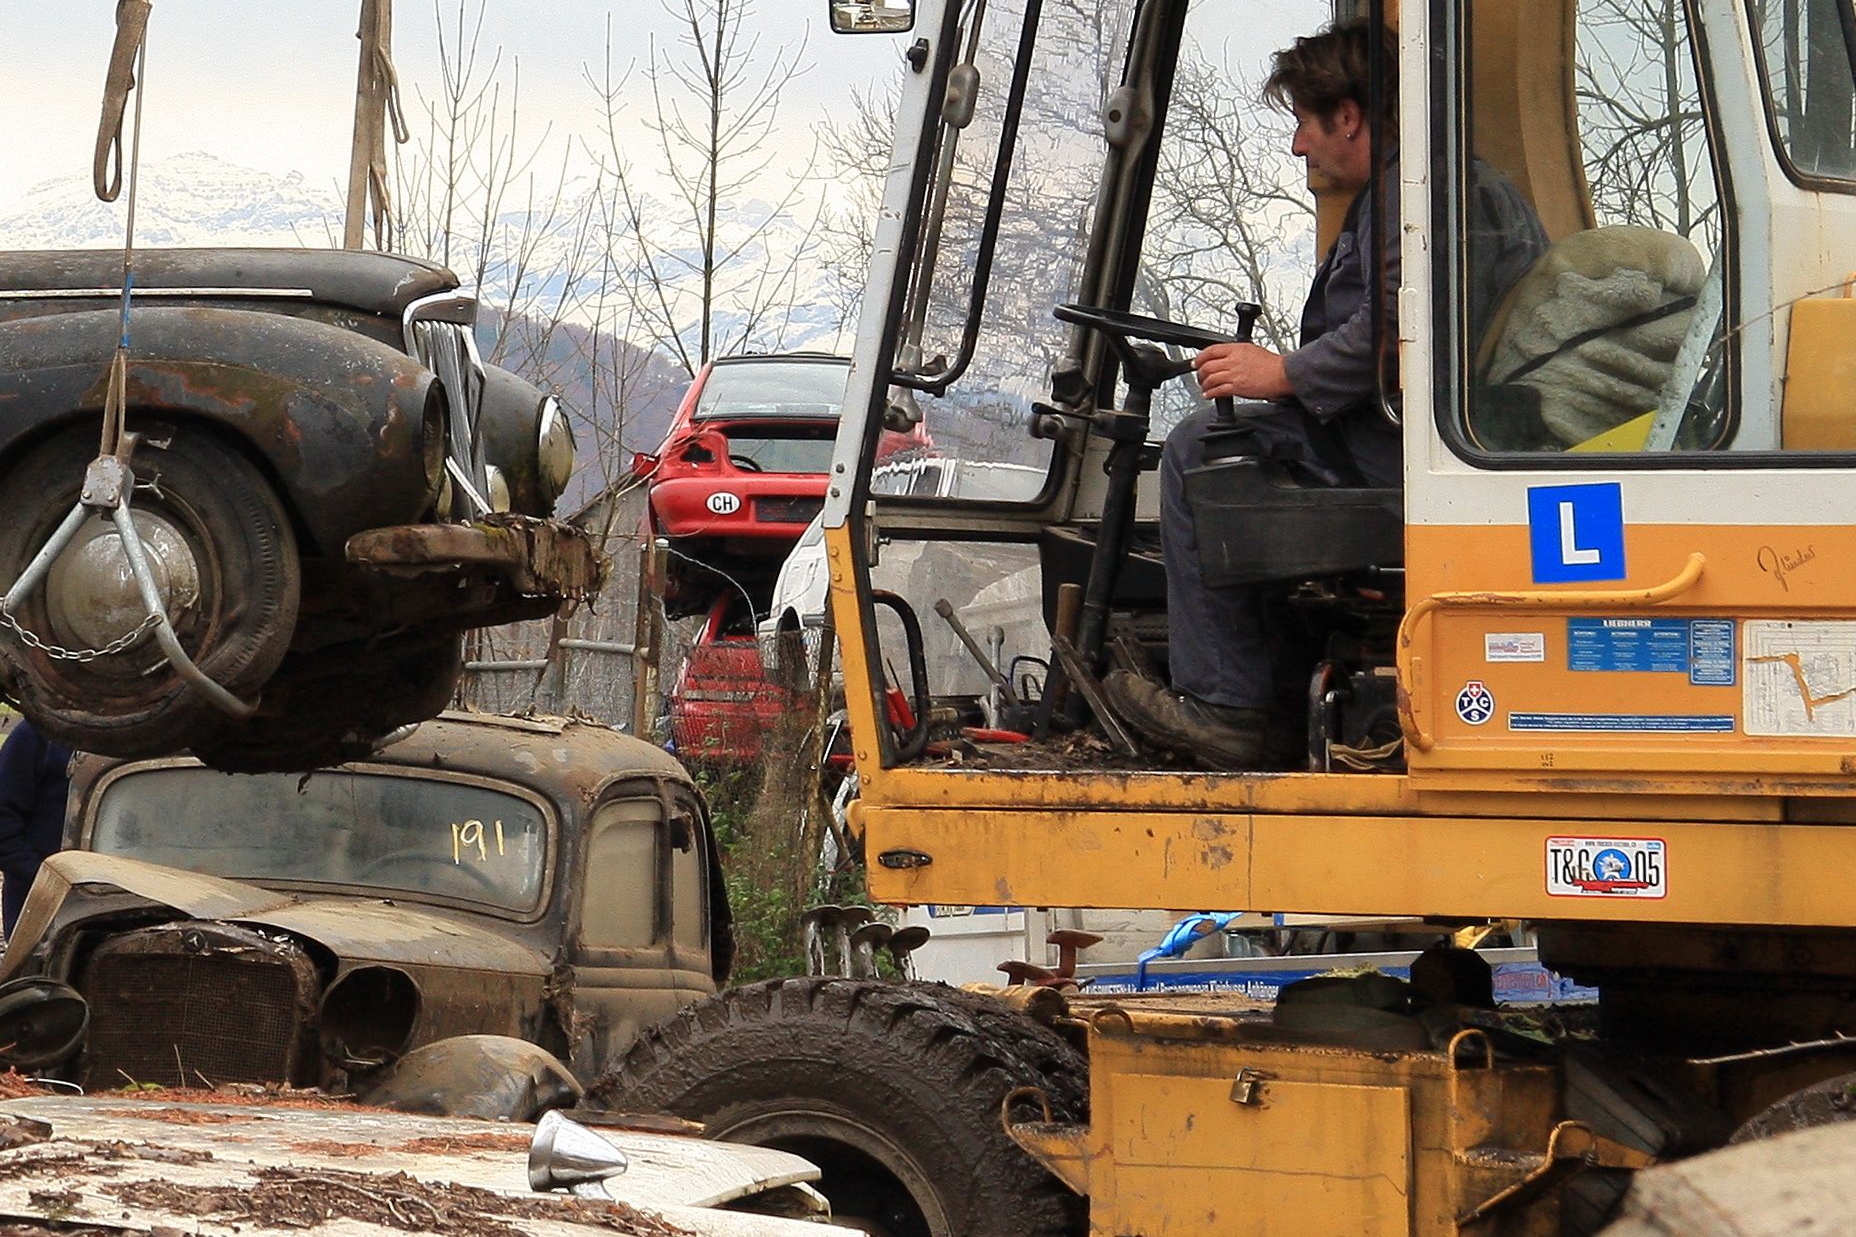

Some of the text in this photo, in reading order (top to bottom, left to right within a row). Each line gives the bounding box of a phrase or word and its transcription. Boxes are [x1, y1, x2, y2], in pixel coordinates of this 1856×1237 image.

[711, 492, 734, 514] CH
[1559, 502, 1601, 566] L
[450, 819, 506, 865] 191
[1635, 850, 1660, 887] 05
